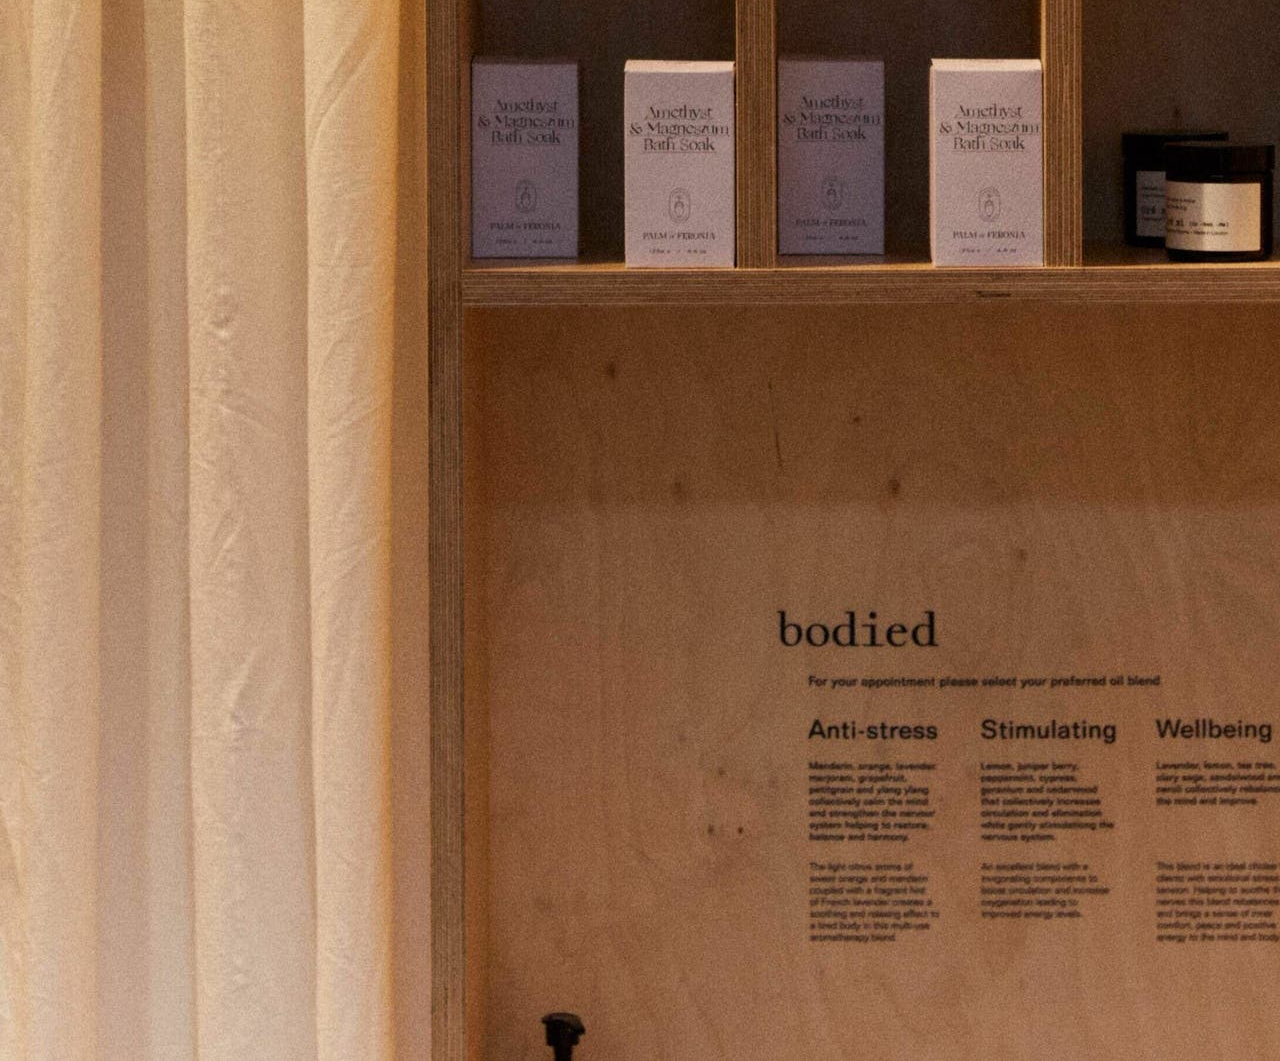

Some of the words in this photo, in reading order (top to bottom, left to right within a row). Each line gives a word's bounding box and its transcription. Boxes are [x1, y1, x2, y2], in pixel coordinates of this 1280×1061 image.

[644, 105, 713, 120] Amethyst
[955, 104, 1023, 119] Amethyst
[630, 123, 643, 135] &
[939, 122, 953, 134] &
[643, 137, 675, 150] Bath
[680, 137, 715, 150] Soak
[953, 137, 985, 150] Bath
[990, 136, 1025, 150] Soak
[642, 232, 667, 240] PALM
[953, 231, 977, 239] PALM
[778, 610, 938, 648] bodied
[808, 676, 828, 686] For
[831, 678, 857, 689] your
[861, 676, 935, 688] appointment
[939, 676, 978, 688] please
[982, 676, 1017, 686] select
[1020, 678, 1046, 689] your
[1050, 676, 1106, 688] preferred
[1110, 676, 1124, 686] oil
[1127, 675, 1160, 686] blend
[808, 720, 938, 740] Anti-stress
[981, 720, 1117, 743] Stimulating
[1156, 719, 1272, 742] Wellbeing
